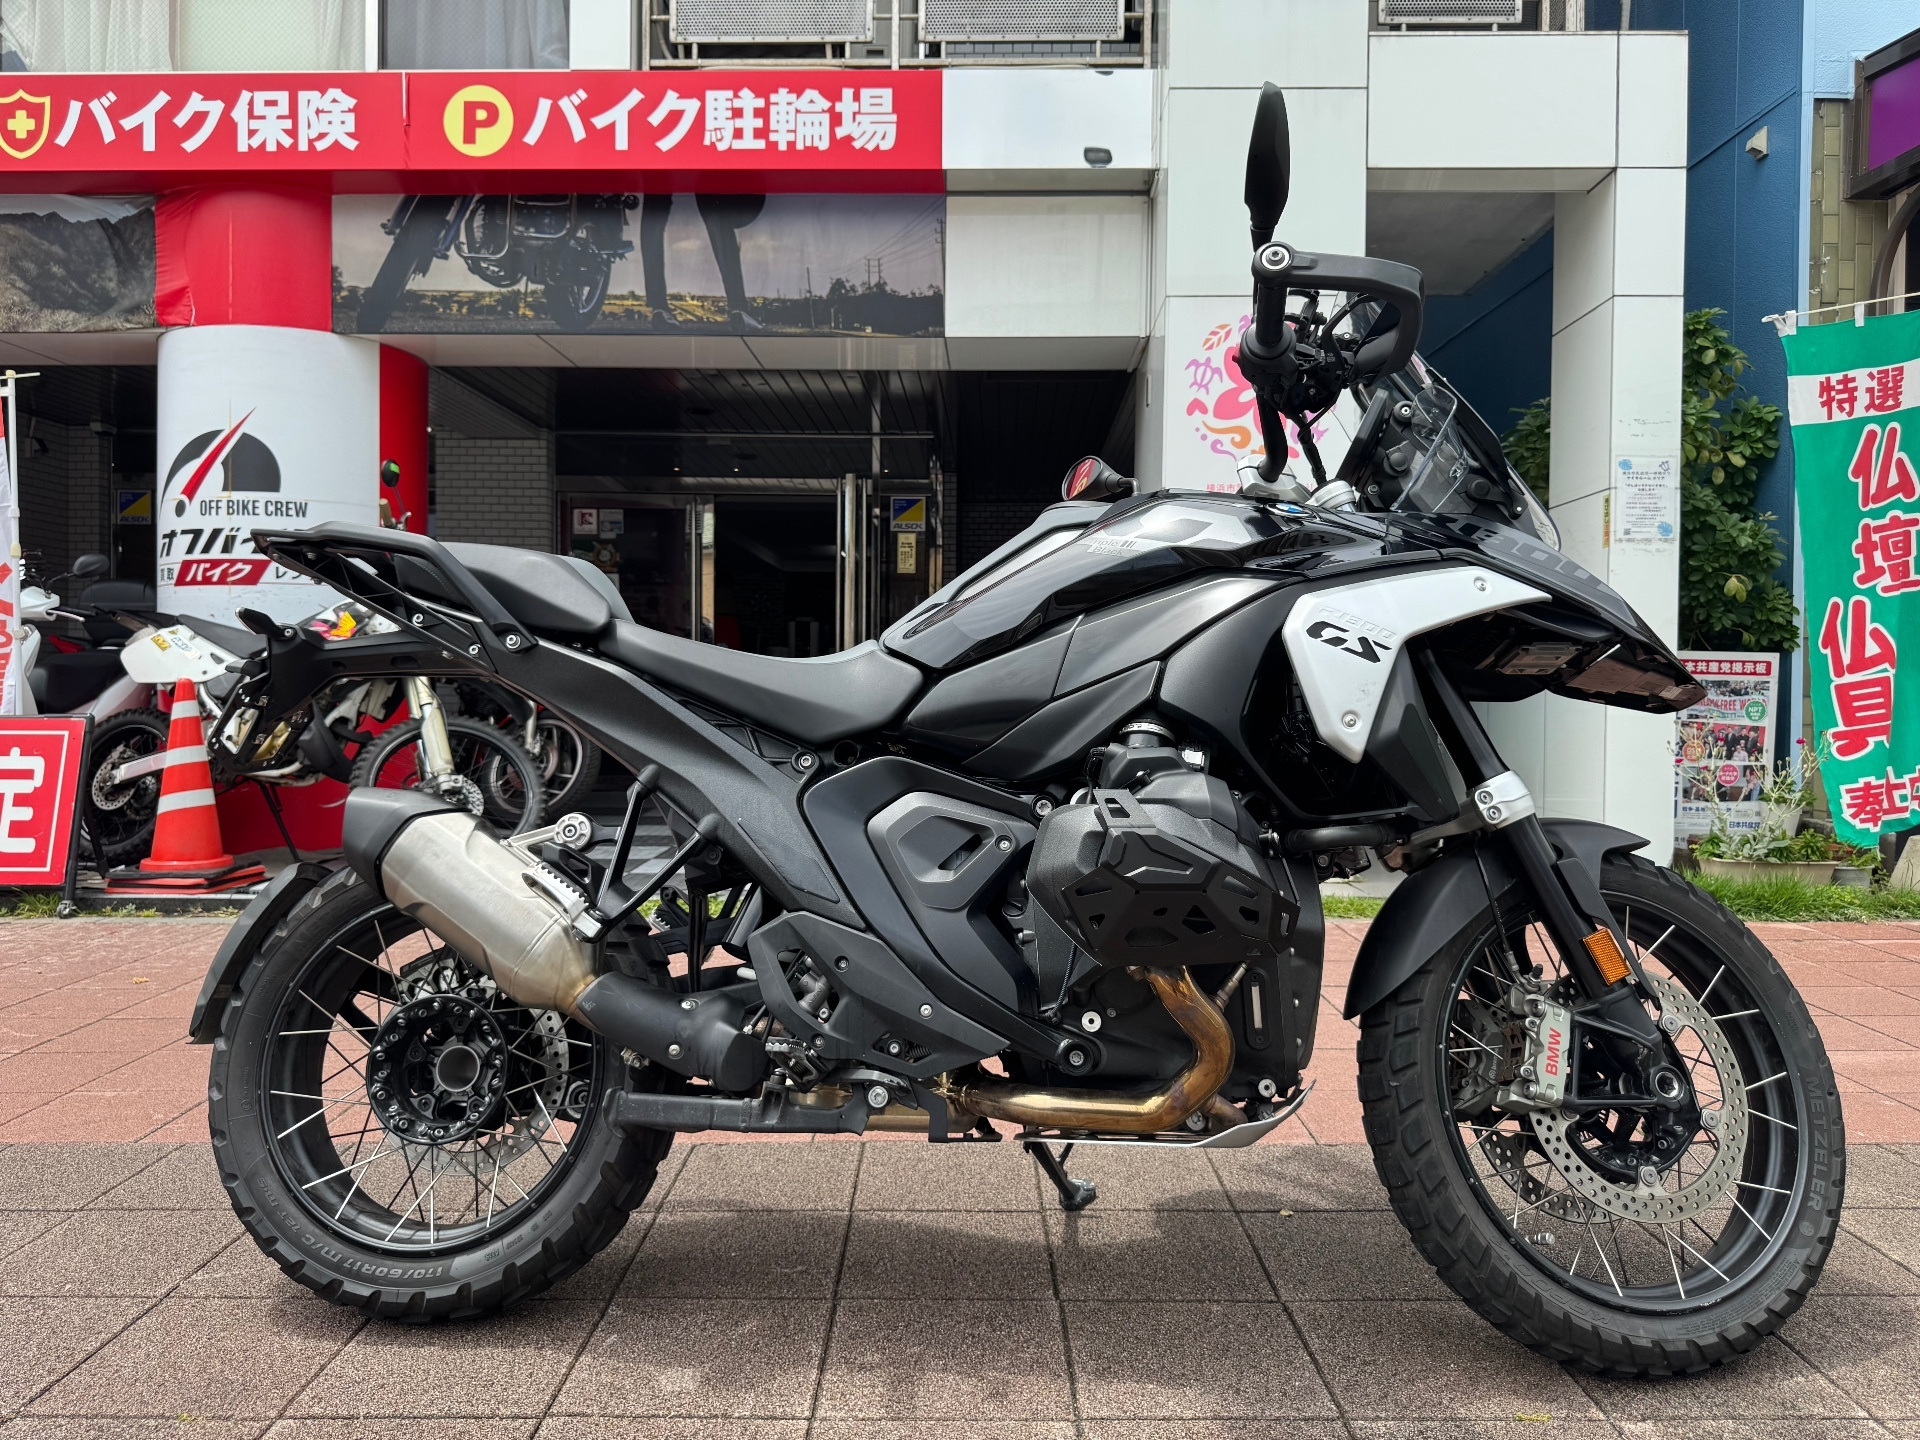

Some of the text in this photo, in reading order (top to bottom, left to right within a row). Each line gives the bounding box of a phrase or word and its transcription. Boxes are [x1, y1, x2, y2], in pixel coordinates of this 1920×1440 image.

[54, 88, 359, 153] バイク保険
[463, 101, 499, 146] P
[522, 86, 898, 152] バイク駐輪場
[1818, 365, 1905, 421] 特選
[200, 499, 308, 518] OFF BIKE CREW
[892, 522, 923, 530] ALSOK
[1850, 425, 1920, 595] 仏壇
[185, 562, 253, 582] バイク
[1306, 620, 1393, 664] GS
[1680, 661, 1767, 674] 本共産党掲示板
[1821, 600, 1896, 758] 仏具
[1544, 1026, 1562, 1077] BMW
[1804, 1075, 1828, 1211] METZELER
[343, 1257, 443, 1280] 170/60R17
